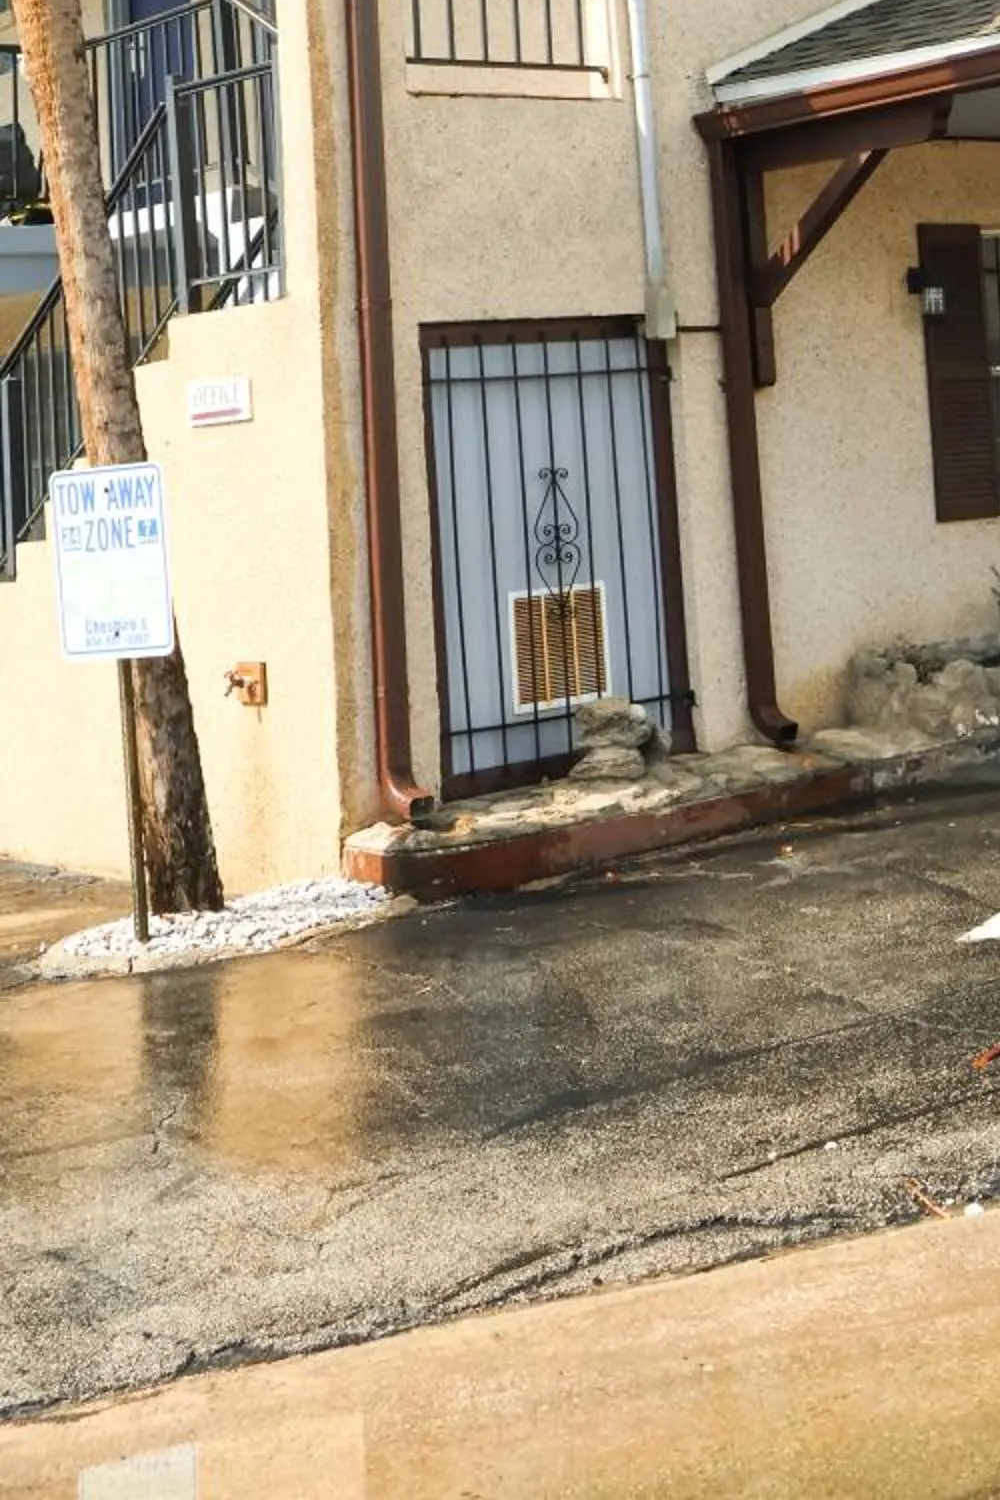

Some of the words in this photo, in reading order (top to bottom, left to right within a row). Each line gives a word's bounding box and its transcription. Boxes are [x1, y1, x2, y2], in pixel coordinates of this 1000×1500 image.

[56, 479, 95, 517] TOW
[105, 474, 155, 511] AWAY
[84, 515, 136, 553] ZONE
